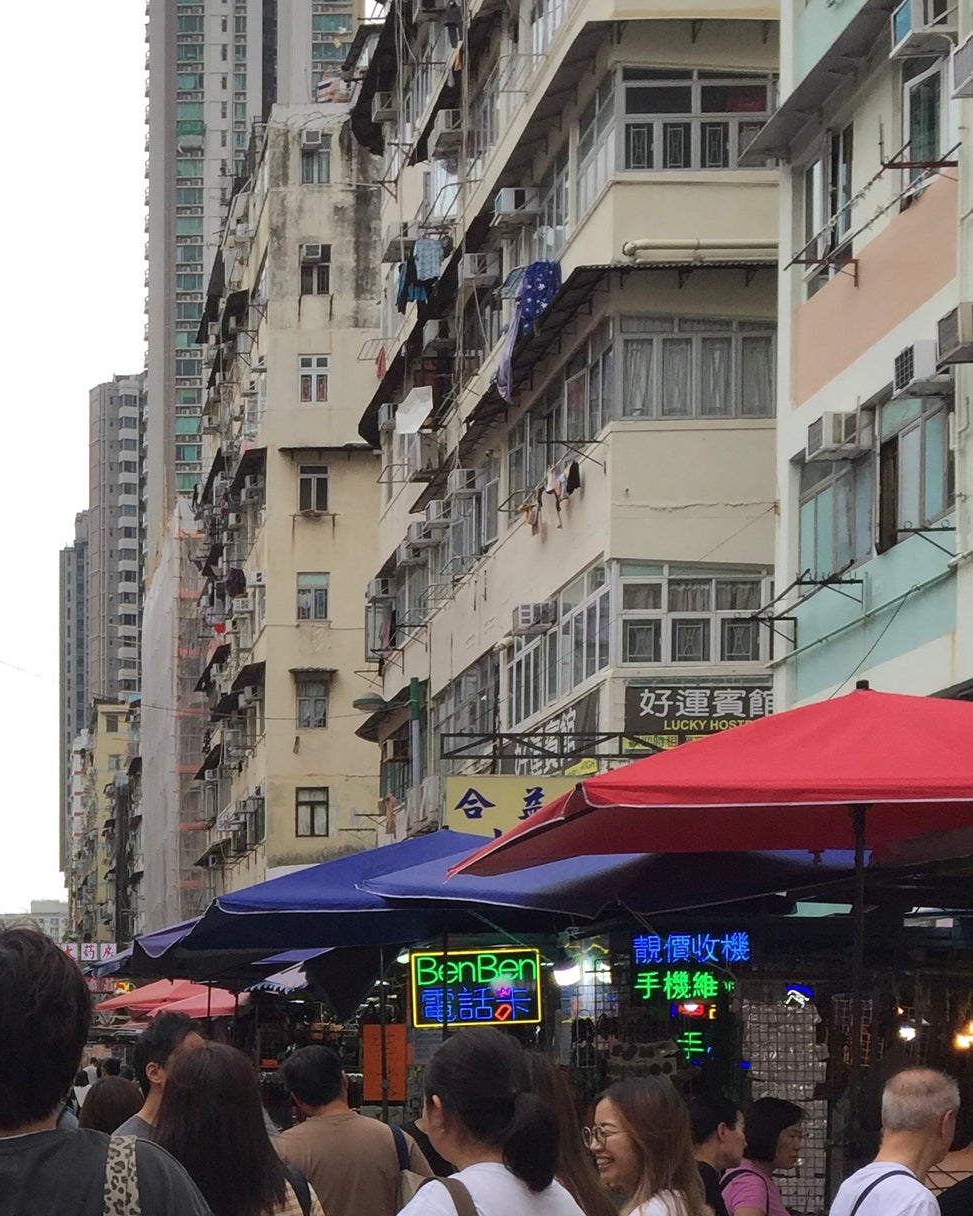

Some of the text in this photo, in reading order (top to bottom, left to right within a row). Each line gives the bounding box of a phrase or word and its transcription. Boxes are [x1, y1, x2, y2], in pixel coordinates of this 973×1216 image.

[639, 688, 774, 718] 好運賓館
[664, 719, 753, 731] LUCKY HOST
[633, 931, 751, 963] 靚價收機
[417, 954, 537, 986] BenBen
[420, 985, 532, 1022] 電話卡
